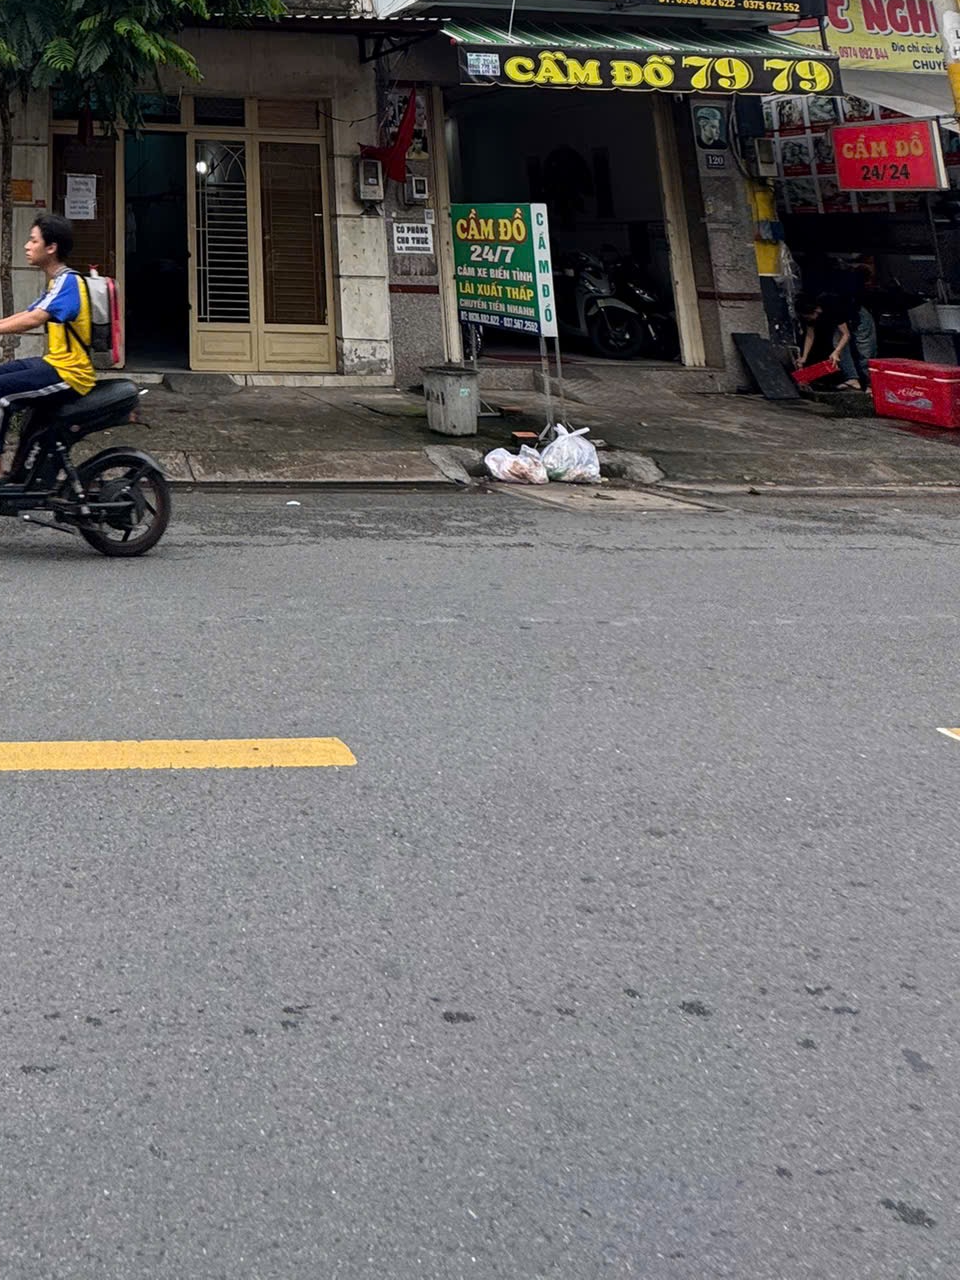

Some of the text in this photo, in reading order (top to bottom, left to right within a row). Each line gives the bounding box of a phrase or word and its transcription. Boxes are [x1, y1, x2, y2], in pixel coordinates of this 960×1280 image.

[743, 0, 765, 10] 0375
[766, 1, 782, 11] 672
[783, 2, 800, 12] 552
[891, 42, 905, 56] Địa
[504, 51, 603, 86] CẦM
[610, 55, 675, 88] ĐỒ
[682, 55, 754, 90] 79
[763, 58, 834, 93] 79
[842, 131, 924, 159] CẦM ĐỒ
[708, 156, 724, 165] 120
[456, 207, 526, 242] CẦM ĐỒ
[396, 236, 409, 244] CHO
[470, 245, 515, 264] 24/7
[477, 267, 489, 278] XE
[477, 281, 504, 298] XUẤT
[505, 285, 534, 301] THẤP
[507, 303, 536, 317] NHANH
